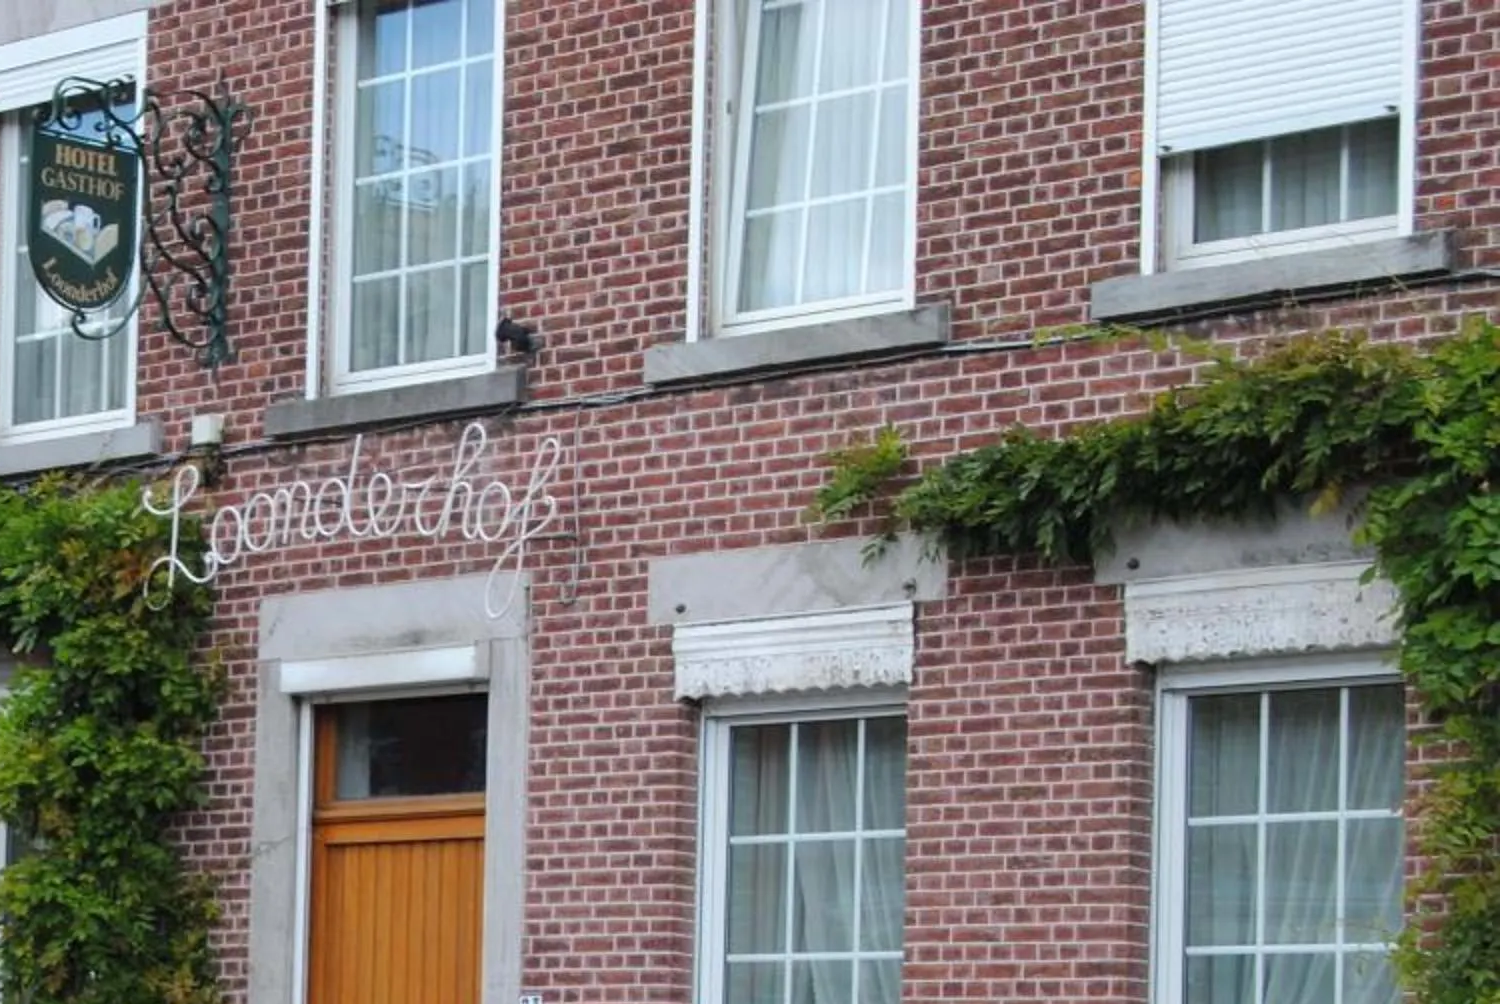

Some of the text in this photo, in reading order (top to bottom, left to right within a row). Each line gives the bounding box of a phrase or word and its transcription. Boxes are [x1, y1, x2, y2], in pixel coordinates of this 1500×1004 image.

[56, 144, 117, 176] HOTEL
[41, 167, 125, 201] GASTHOF
[143, 423, 560, 618] Loonderhof
